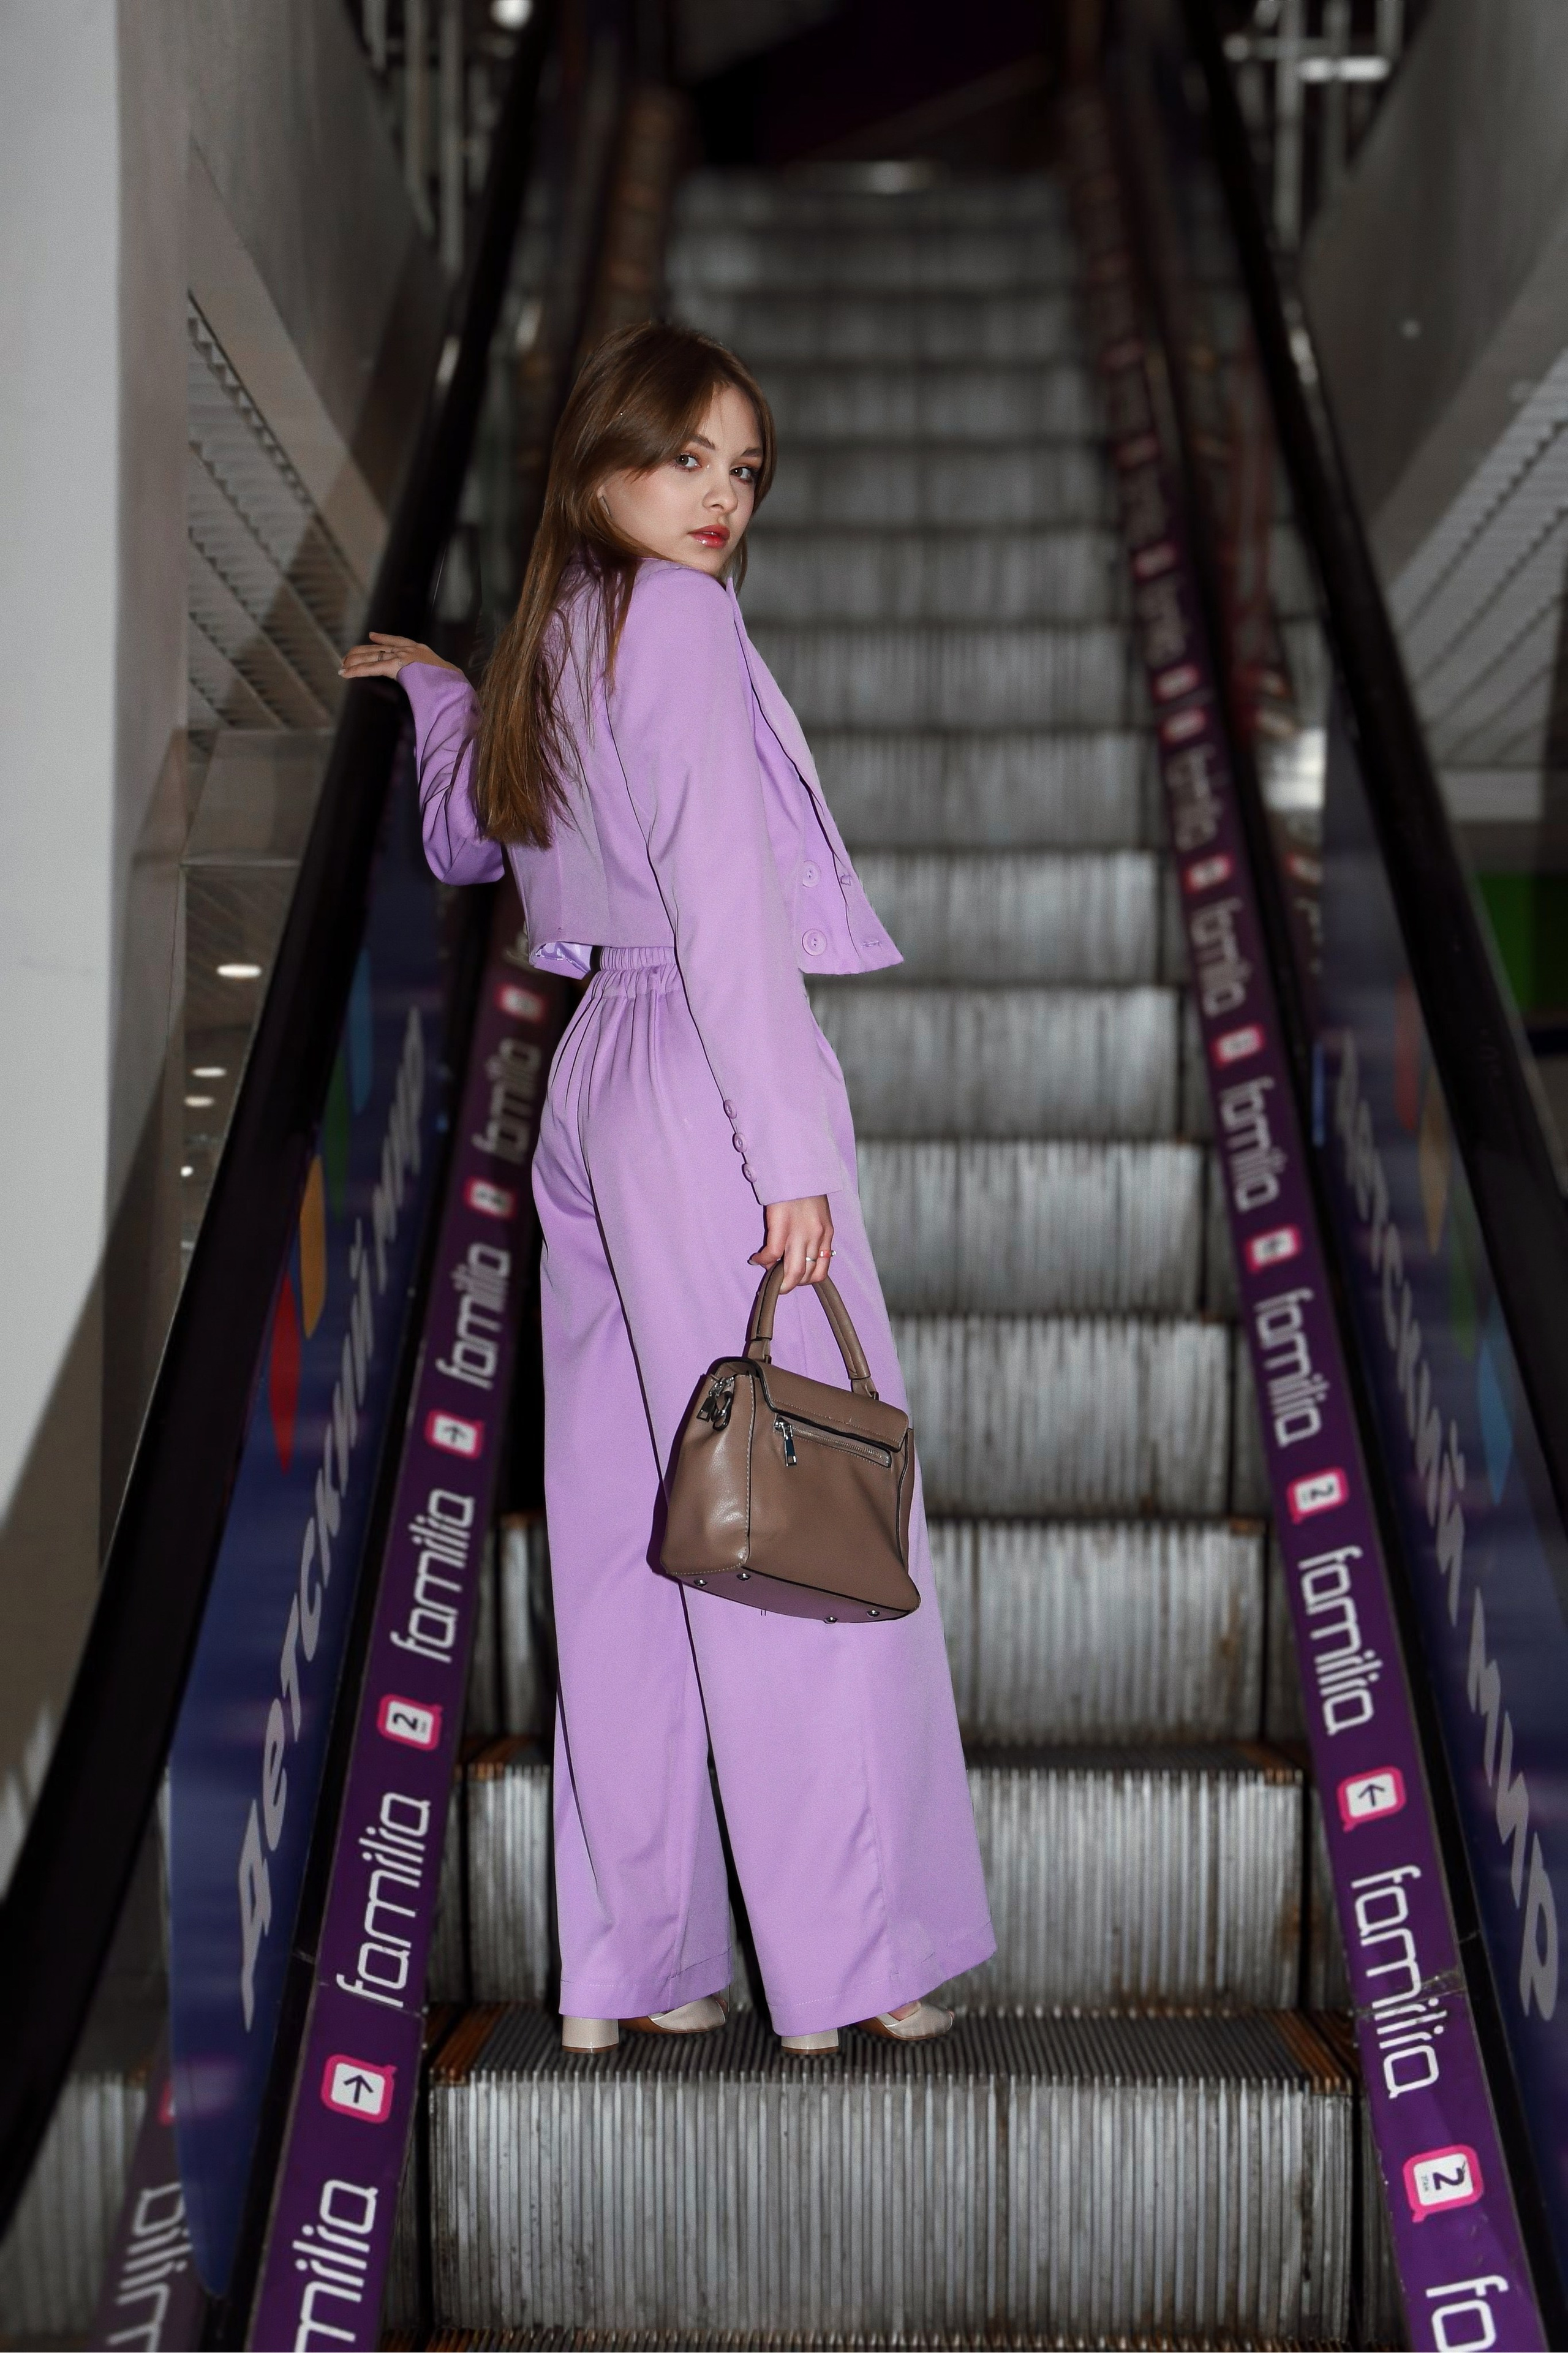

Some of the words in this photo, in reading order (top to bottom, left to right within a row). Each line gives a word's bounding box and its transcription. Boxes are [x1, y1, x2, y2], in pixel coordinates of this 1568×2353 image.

[435, 1243, 510, 1389] familia
[1256, 1288, 1329, 1448] familia
[238, 1217, 374, 2031] Детский
[390, 1489, 475, 1663] familia
[1298, 1545, 1383, 1736] familia
[393, 1713, 418, 1731] 2
[1466, 1585, 1560, 2023] мир
[336, 1792, 431, 2009] familia
[1351, 1865, 1447, 2099] familia
[1432, 2166, 1465, 2191] 2
